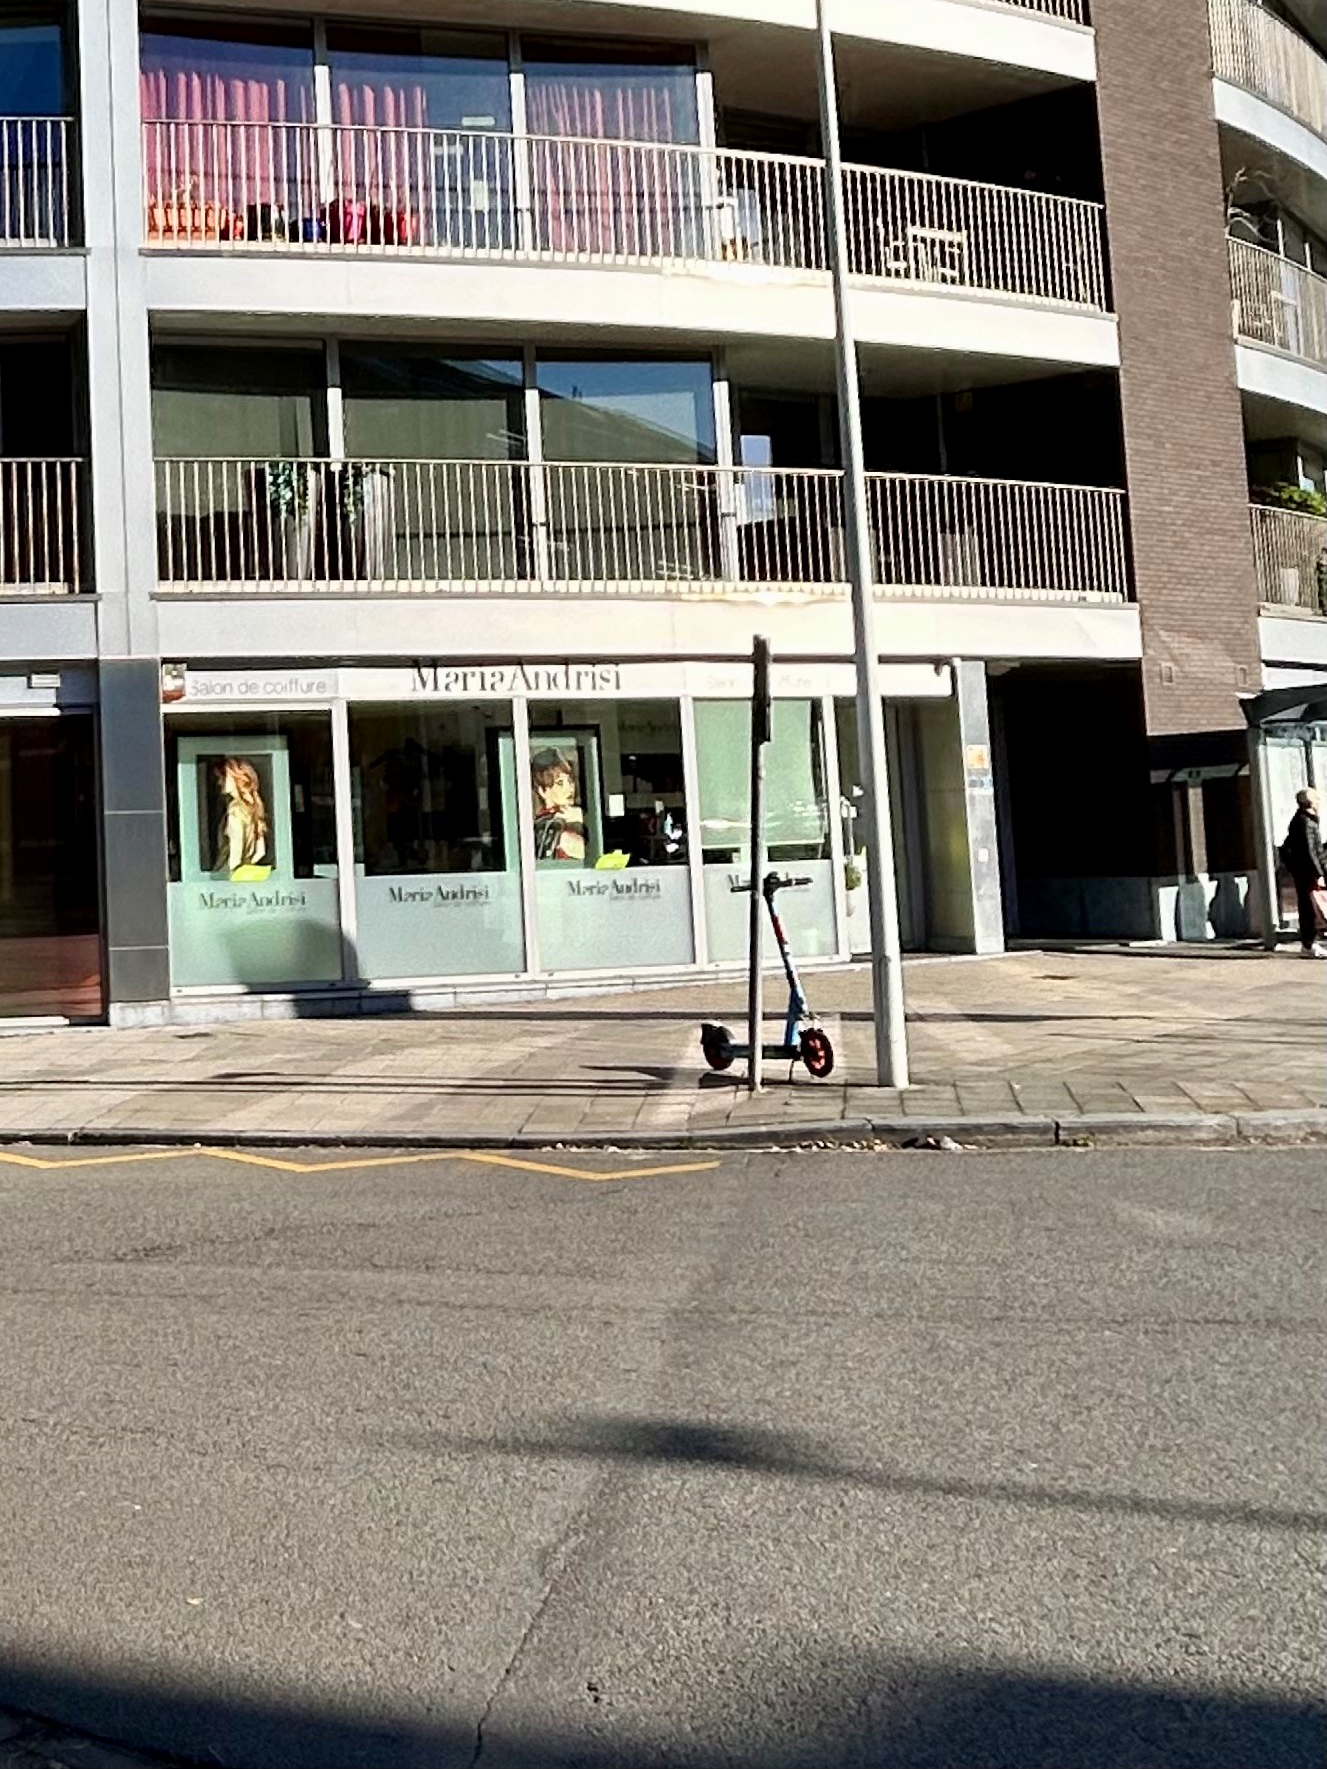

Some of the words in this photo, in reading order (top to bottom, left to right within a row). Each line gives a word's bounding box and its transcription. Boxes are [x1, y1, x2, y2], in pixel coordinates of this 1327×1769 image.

[191, 678, 233, 696] Salon
[237, 678, 259, 695] de
[262, 678, 327, 695] coiffure
